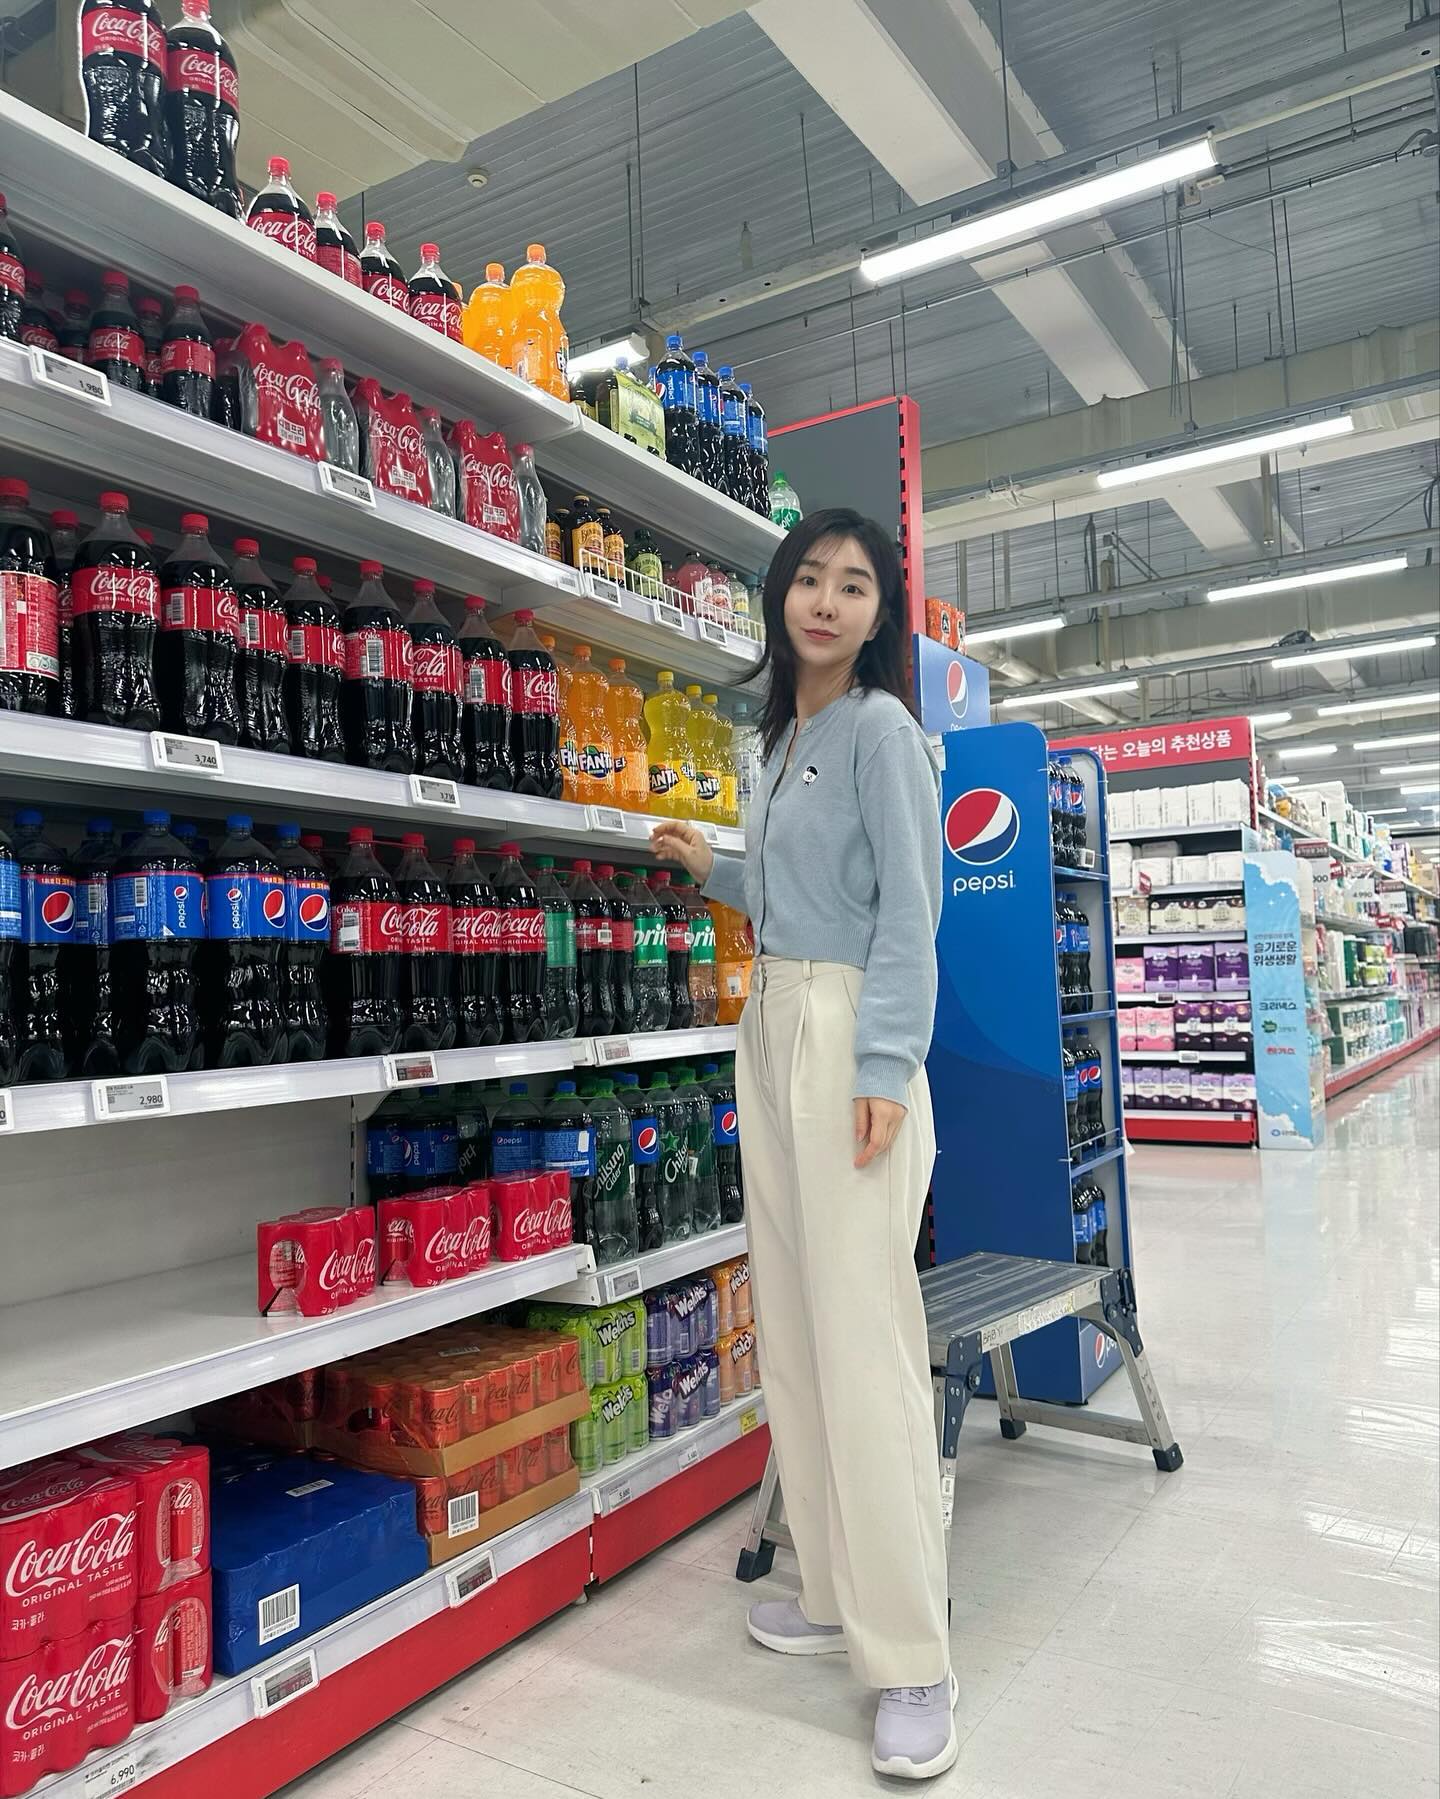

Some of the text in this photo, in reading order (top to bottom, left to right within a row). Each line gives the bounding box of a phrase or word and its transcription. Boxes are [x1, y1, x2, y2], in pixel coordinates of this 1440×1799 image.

[92, 12, 162, 51] Coca-Cola
[180, 53, 239, 98] Coca-Cola
[251, 215, 316, 255] Coca-Cola
[370, 278, 409, 314] Coca-C
[79, 380, 103, 395] 1,980
[253, 362, 321, 410] Coca-Cola
[91, 571, 158, 603] Coca-Cola
[1122, 737, 1166, 758] 오늘의
[1171, 729, 1232, 754] 추천상품
[194, 754, 217, 765] 3,740
[650, 769, 679, 788] ANTA
[697, 777, 720, 793] ANT
[952, 870, 1015, 896] pepsi
[178, 901, 187, 929] pepsi
[232, 903, 240, 929] pepsi
[452, 911, 500, 938] ca-Cola
[501, 912, 546, 938] Coca-Co
[634, 923, 668, 946] prit
[689, 925, 716, 947] prit
[1254, 941, 1297, 954] 슬기로운
[1254, 954, 1297, 966] 위생생활
[503, 1136, 522, 1144] pepsi
[605, 1165, 622, 1191] Cider
[514, 1197, 571, 1242] Coca-Cola
[424, 1216, 491, 1264] Coca-Cola
[319, 1238, 375, 1290] Coca-Cola
[1, 1478, 86, 1512] Coca-Cola
[5, 1511, 138, 1597] Coca-Cola
[22, 1580, 84, 1608] ORIGINAL
[87, 1560, 125, 1582] TASTE
[5, 1631, 135, 1730] Coca-Cola
[23, 1689, 121, 1741] ORIGINAL TASTE
[110, 1764, 135, 1785] 6,990
